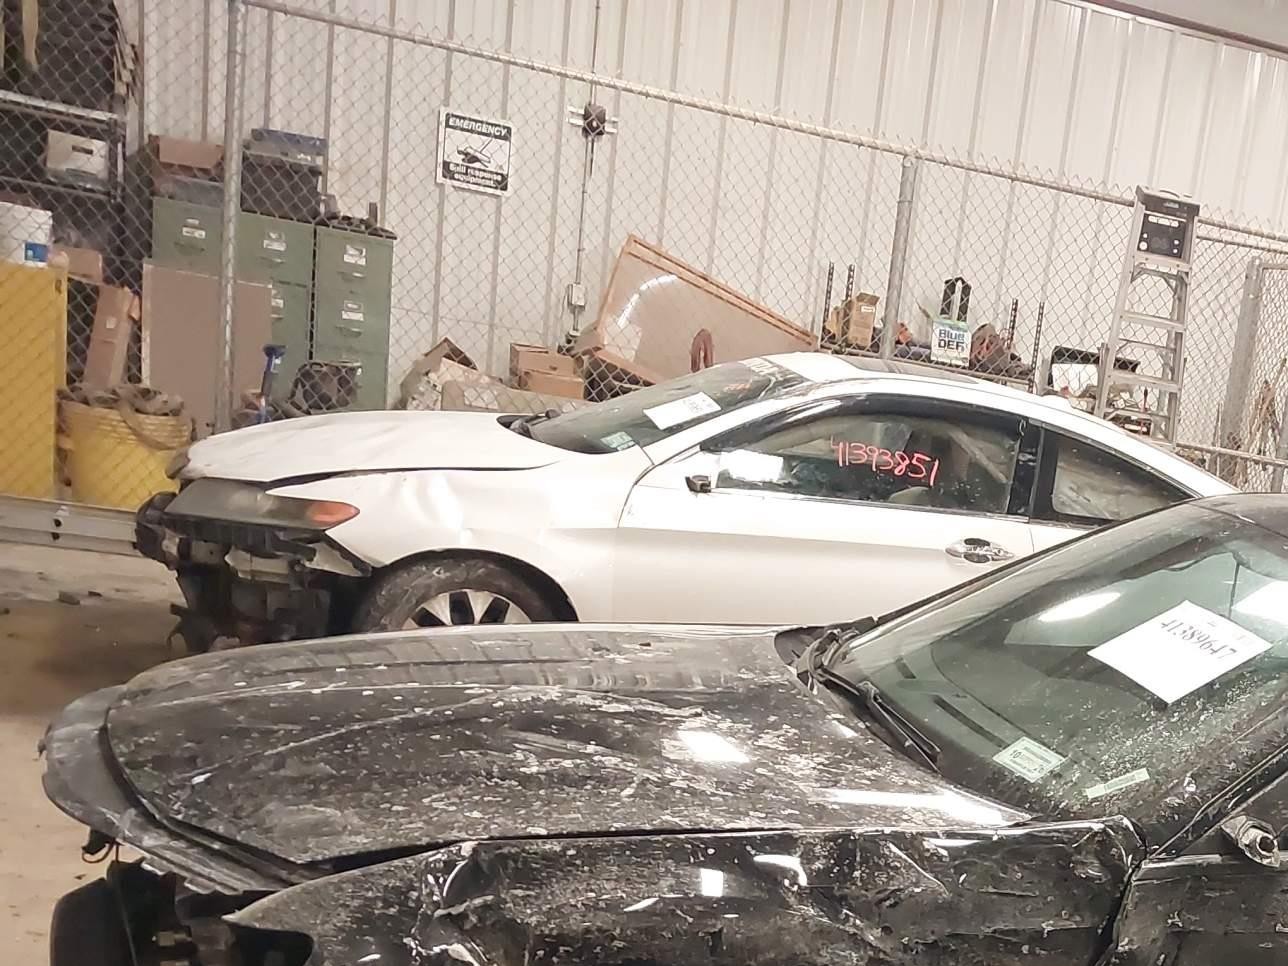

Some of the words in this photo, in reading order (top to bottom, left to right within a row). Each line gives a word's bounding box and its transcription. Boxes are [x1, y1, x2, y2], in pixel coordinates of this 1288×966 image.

[448, 117, 508, 136] EMERGENCY
[937, 339, 965, 353] DEF
[830, 434, 939, 487] 41393851
